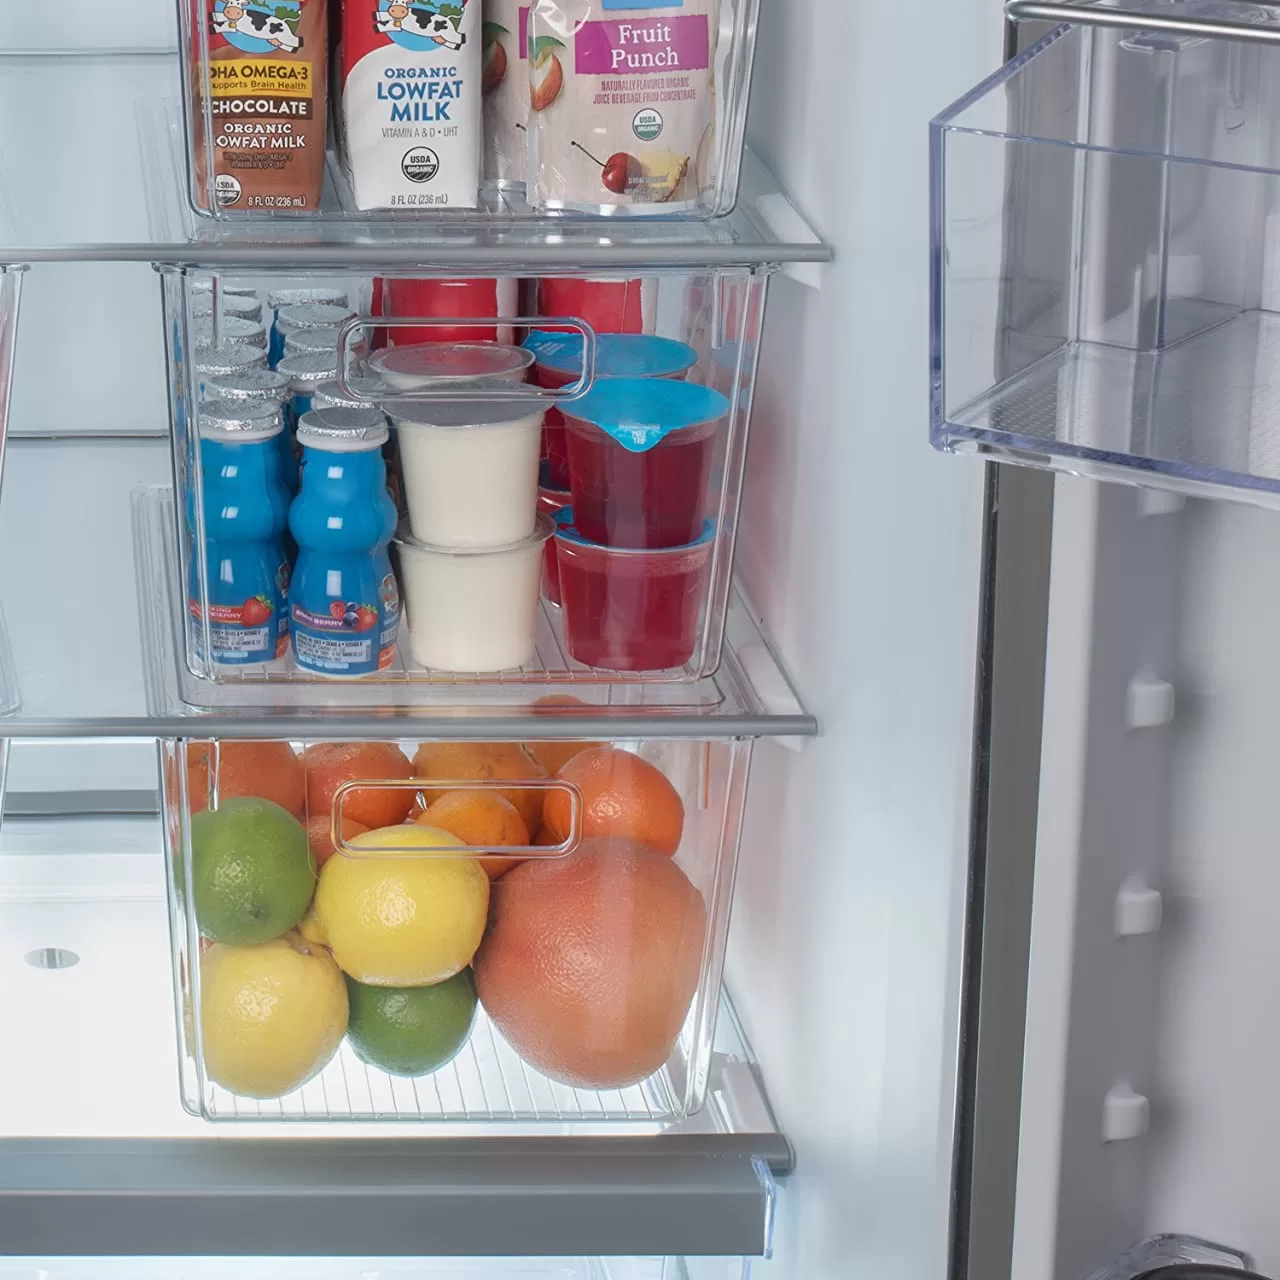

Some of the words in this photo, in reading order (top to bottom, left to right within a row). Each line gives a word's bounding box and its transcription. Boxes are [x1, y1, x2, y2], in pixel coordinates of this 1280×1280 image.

[618, 23, 672, 44] Fruit
[610, 46, 680, 69] Punch
[240, 65, 309, 80] OMEGA-3
[384, 66, 457, 79] ORGANIC
[250, 80, 276, 89] Brain
[277, 82, 307, 90] Health
[377, 80, 464, 100] LOWFAT
[601, 81, 636, 92] NATURALLY
[637, 78, 665, 90] FLAVORED
[666, 76, 690, 88] ORGANIC
[593, 94, 610, 105] JUICE
[611, 93, 642, 105] BEVERAGE
[643, 92, 660, 103] FROM
[660, 89, 697, 102] CONCENTRATE
[211, 100, 308, 115] CHOCOLATE
[390, 101, 452, 122] MILK
[639, 115, 657, 124] USDA
[223, 123, 292, 134] ORGANIC
[381, 127, 413, 138] VITAMIN
[413, 127, 420, 137] A
[421, 127, 428, 137] &
[429, 127, 436, 137] D
[443, 126, 459, 137] UHT
[214, 135, 268, 150] OWFAT
[270, 135, 306, 149] MILK
[410, 155, 431, 164] USDA
[407, 165, 434, 173] ORGANIC
[248, 198, 253, 206] 8
[255, 198, 264, 206] FL
[264, 197, 274, 206] OZ
[276, 197, 292, 207] (236
[293, 196, 306, 206] mL)
[390, 195, 396, 205] 8
[397, 195, 407, 205] FL
[407, 194, 417, 204] OZ
[418, 194, 434, 205] (236
[435, 193, 448, 205] mL)
